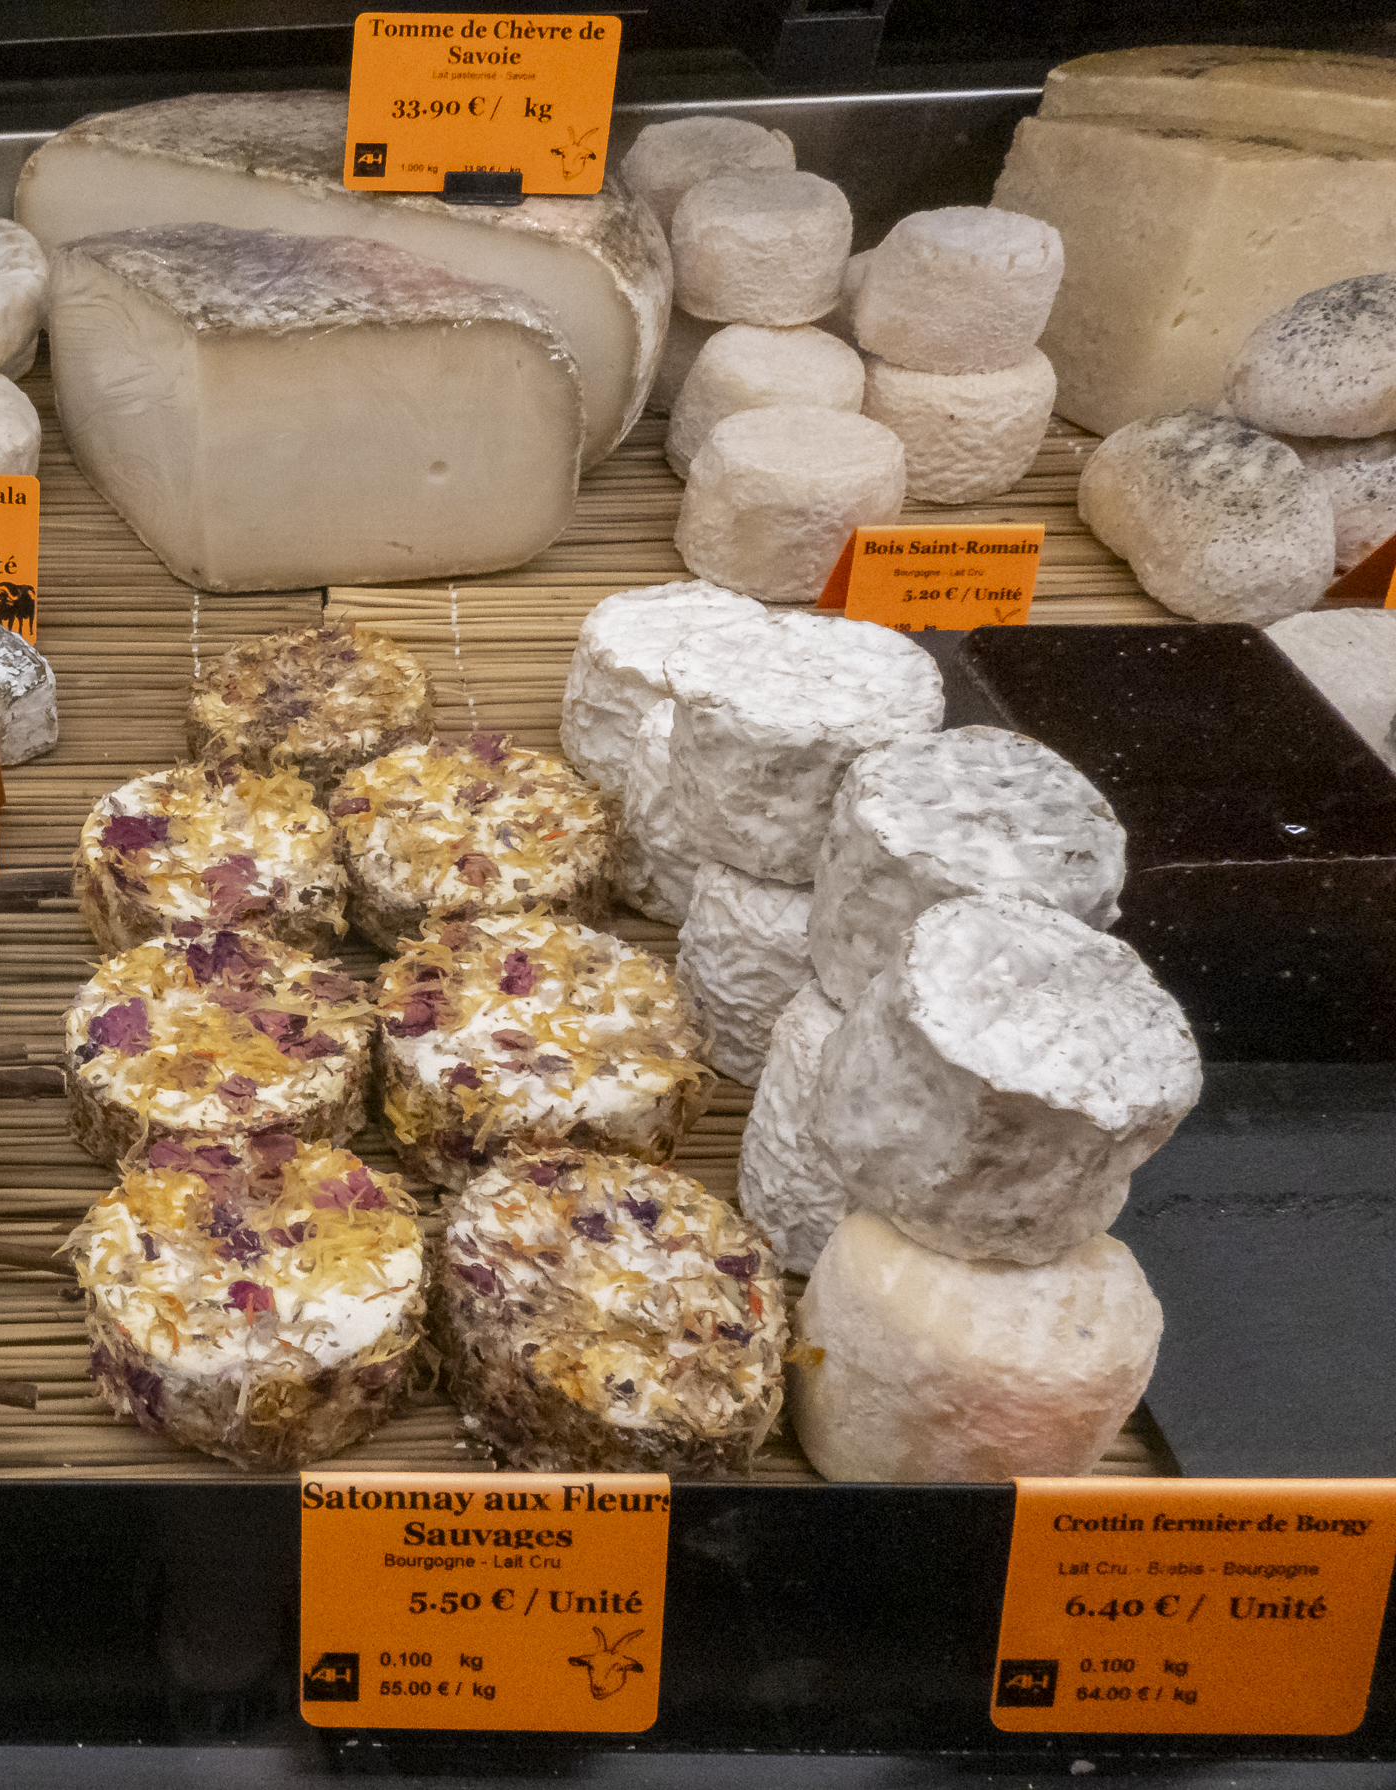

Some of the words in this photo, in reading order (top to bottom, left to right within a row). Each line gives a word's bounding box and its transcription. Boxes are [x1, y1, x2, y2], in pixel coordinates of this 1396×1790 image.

[369, 19, 454, 38] Tomme
[461, 20, 487, 39] de
[494, 20, 572, 40] Chèvre
[579, 21, 605, 40] de
[448, 46, 521, 65] Savoie
[392, 99, 460, 120] 33.90
[468, 97, 486, 117] €
[524, 97, 553, 123] kg
[428, 164, 438, 174] kg
[864, 540, 904, 555] Bois
[908, 539, 1040, 555] Saint-Romain
[903, 588, 940, 603] 5.20
[946, 587, 958, 601] €
[974, 586, 1022, 602] Unité
[302, 1482, 475, 1516] Satonnay
[484, 1490, 551, 1512] aux
[1053, 1513, 1144, 1533] Crottin
[1152, 1513, 1253, 1533] fermier
[1256, 1514, 1288, 1533] de
[1295, 1514, 1374, 1536] Borgy
[404, 1521, 573, 1550] Sauvages
[384, 1553, 476, 1571] Bourgogne
[494, 1554, 524, 1569] Lait
[529, 1555, 562, 1570] Cru
[1058, 1561, 1089, 1576] Lait
[1096, 1561, 1128, 1576] Cru
[1222, 1561, 1320, 1580] Bourgogne
[408, 1591, 482, 1614] 5.50
[491, 1588, 516, 1612] €
[548, 1590, 643, 1614] Unité
[1065, 1594, 1144, 1622] 6.40
[1154, 1594, 1180, 1617] €
[1229, 1595, 1328, 1620] Unité
[380, 1652, 432, 1668] 0.100
[460, 1652, 484, 1672] kg
[1080, 1658, 1136, 1673] 0.100
[1164, 1658, 1189, 1678] kg
[379, 1680, 432, 1696] 55.00
[436, 1681, 450, 1696] €
[472, 1681, 496, 1700] kg
[1076, 1686, 1132, 1701] 64.00
[1172, 1686, 1198, 1706] kg
